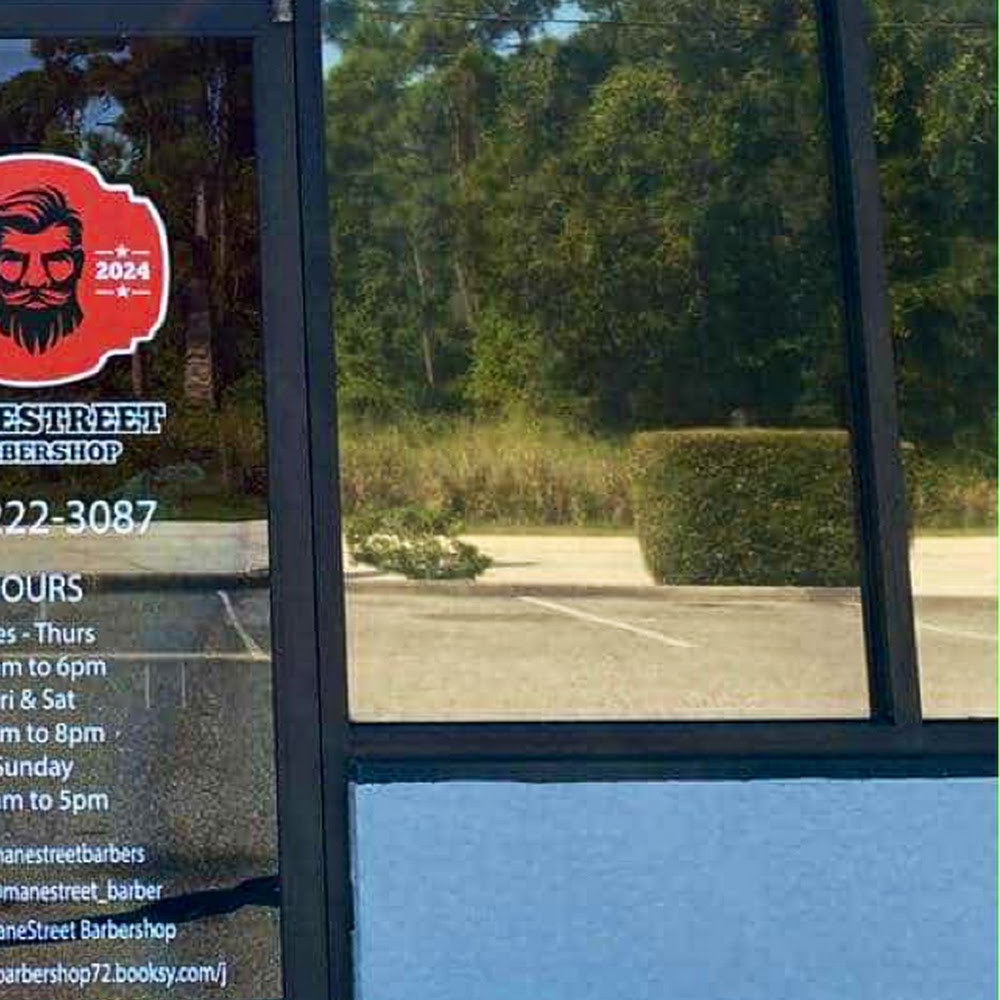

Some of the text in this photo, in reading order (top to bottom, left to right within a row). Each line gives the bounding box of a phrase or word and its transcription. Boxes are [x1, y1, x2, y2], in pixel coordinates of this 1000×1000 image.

[95, 262, 150, 281] 2024
[34, 622, 96, 644] Thurs
[29, 658, 51, 677] to
[57, 657, 106, 681] 6pm
[20, 690, 38, 710] &
[43, 689, 75, 710] Sat
[27, 725, 49, 743] to
[55, 724, 105, 748] 8pm
[30, 792, 53, 810] to
[60, 791, 109, 815] 5pm
[81, 918, 177, 943] Barbershop
